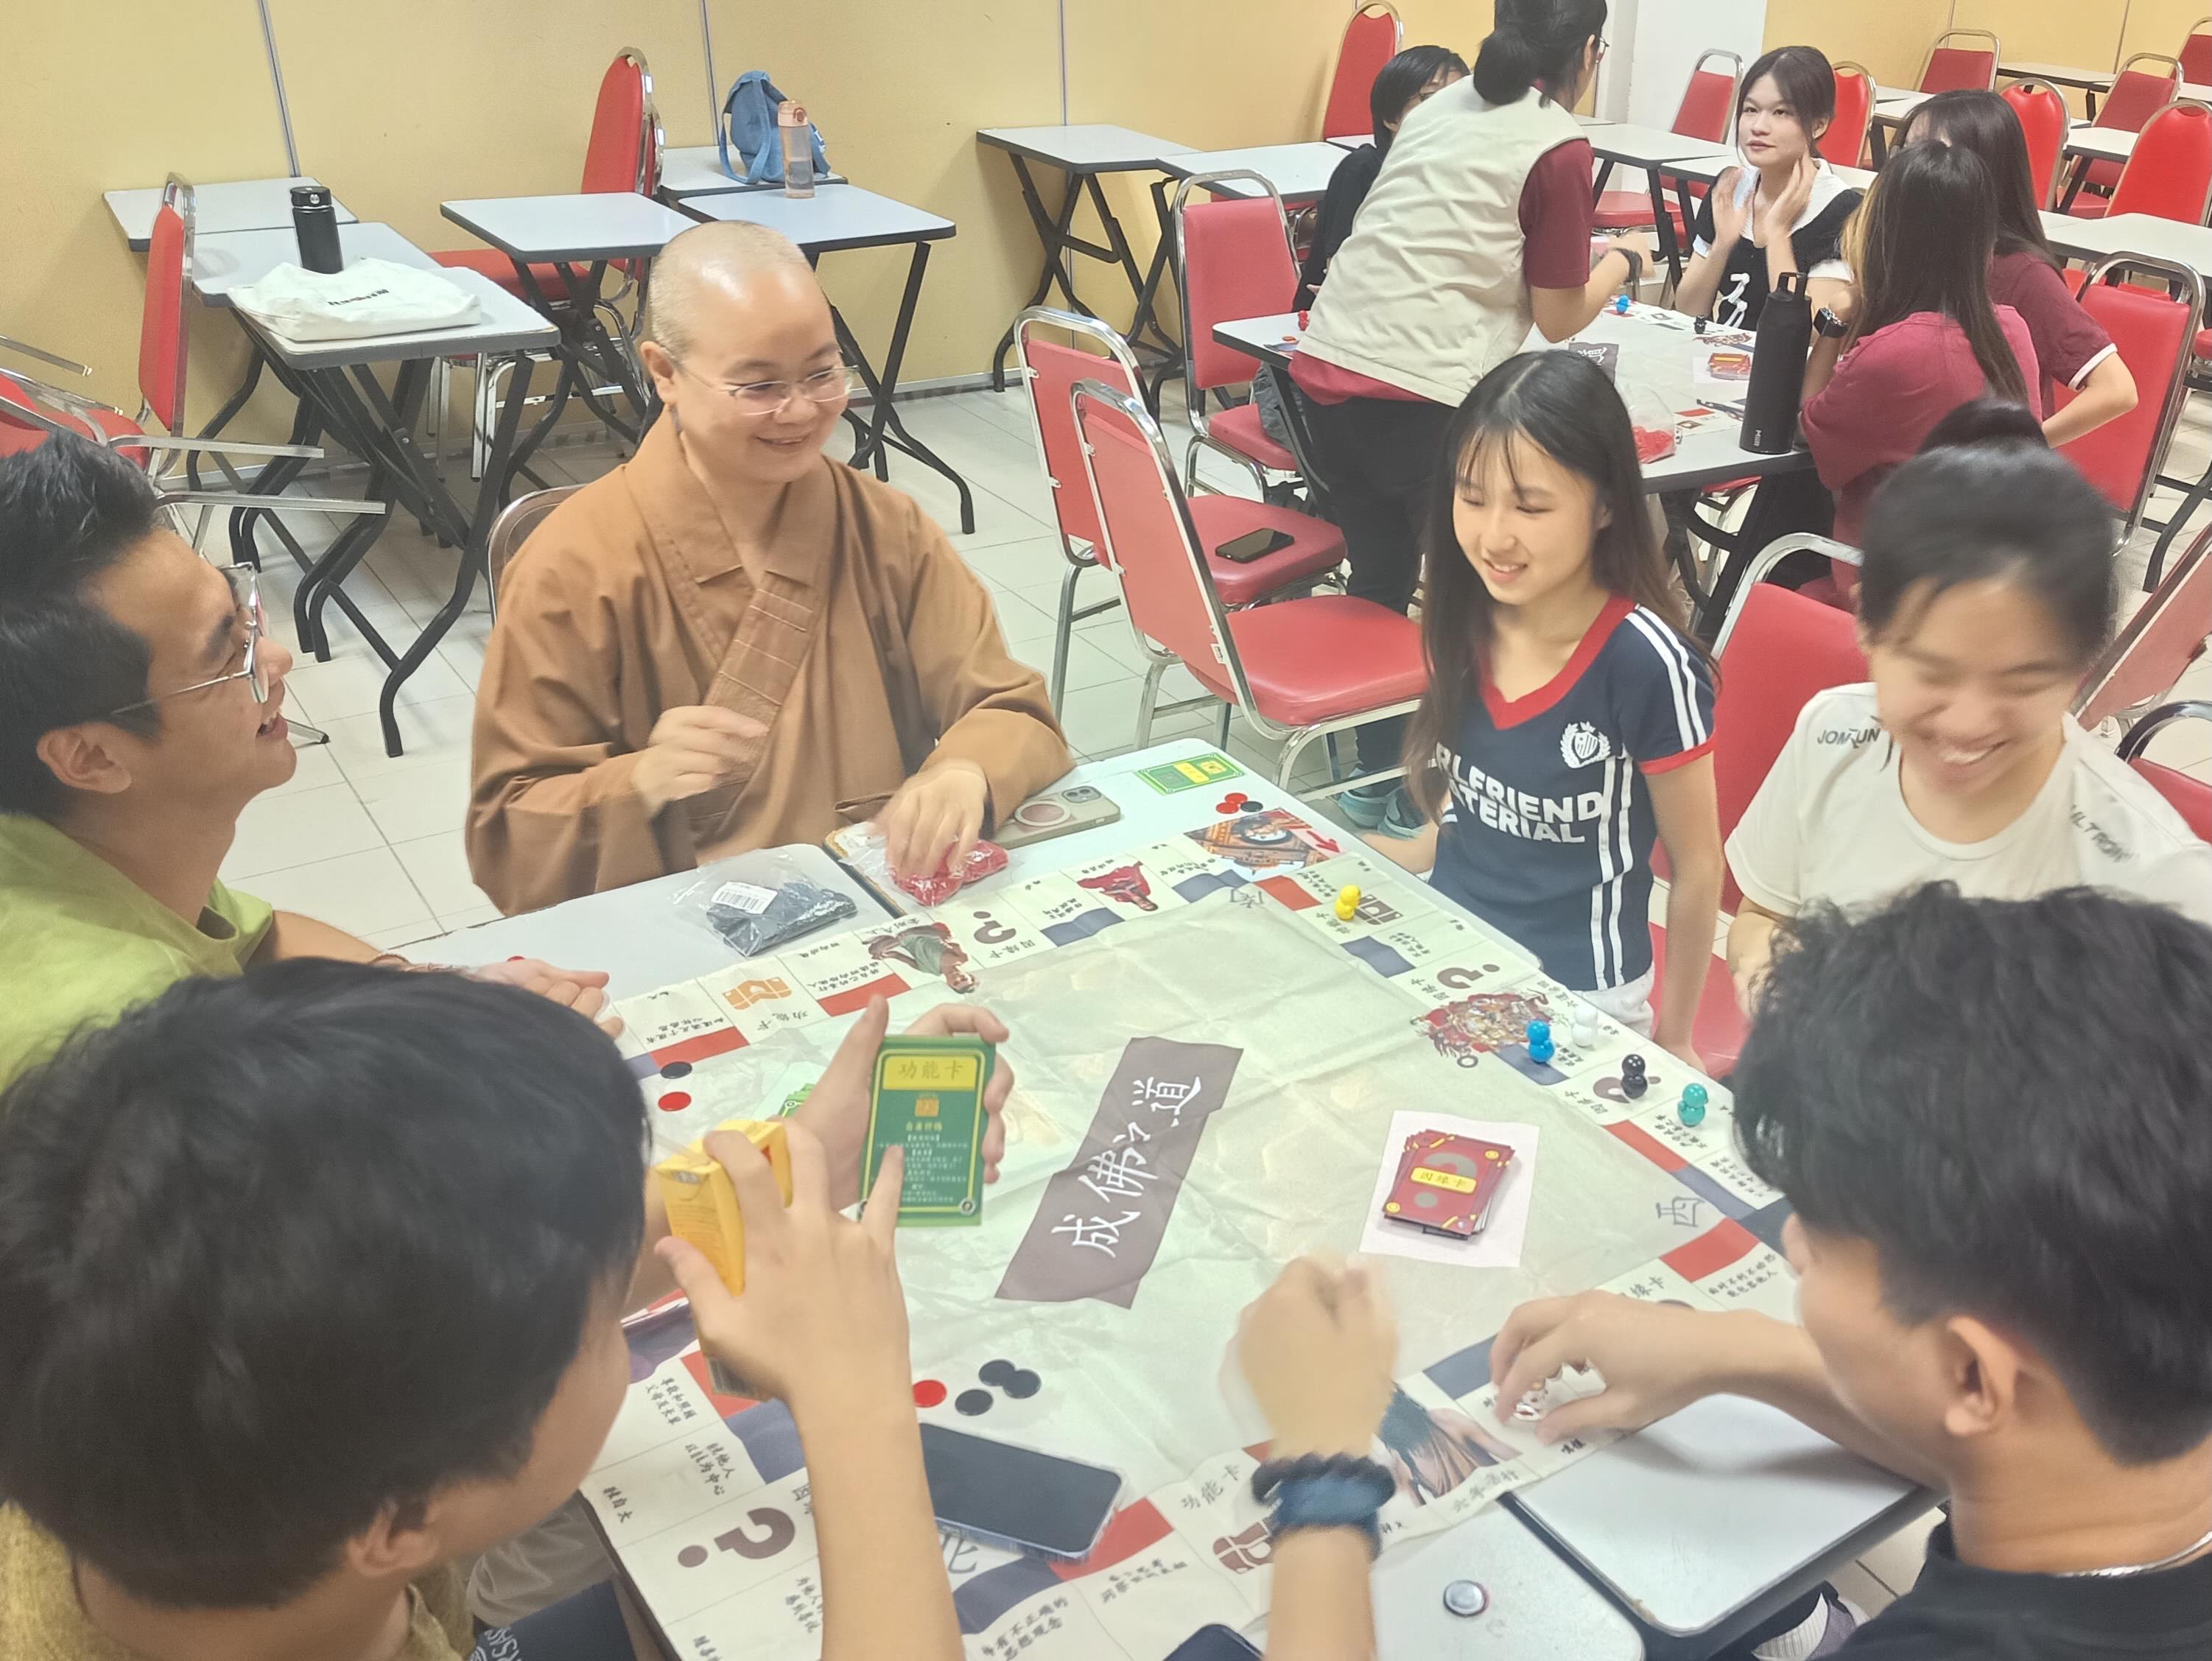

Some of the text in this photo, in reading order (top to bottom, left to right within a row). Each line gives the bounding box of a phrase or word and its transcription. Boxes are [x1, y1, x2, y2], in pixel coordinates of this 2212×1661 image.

[1436, 742, 1604, 824] RLFRIEND
[990, 938, 1036, 958] 因缘卡
[1410, 977, 1450, 1001] 因缘卡
[756, 1011, 809, 1032] 功能卡
[899, 1061, 963, 1080] 功能卡
[1050, 1076, 1202, 1259] 成佛之道
[1420, 1171, 1467, 1188] 因缘卡
[1621, 1276, 1666, 1300] 缘卡
[1180, 1463, 1243, 1511] 功能卡
